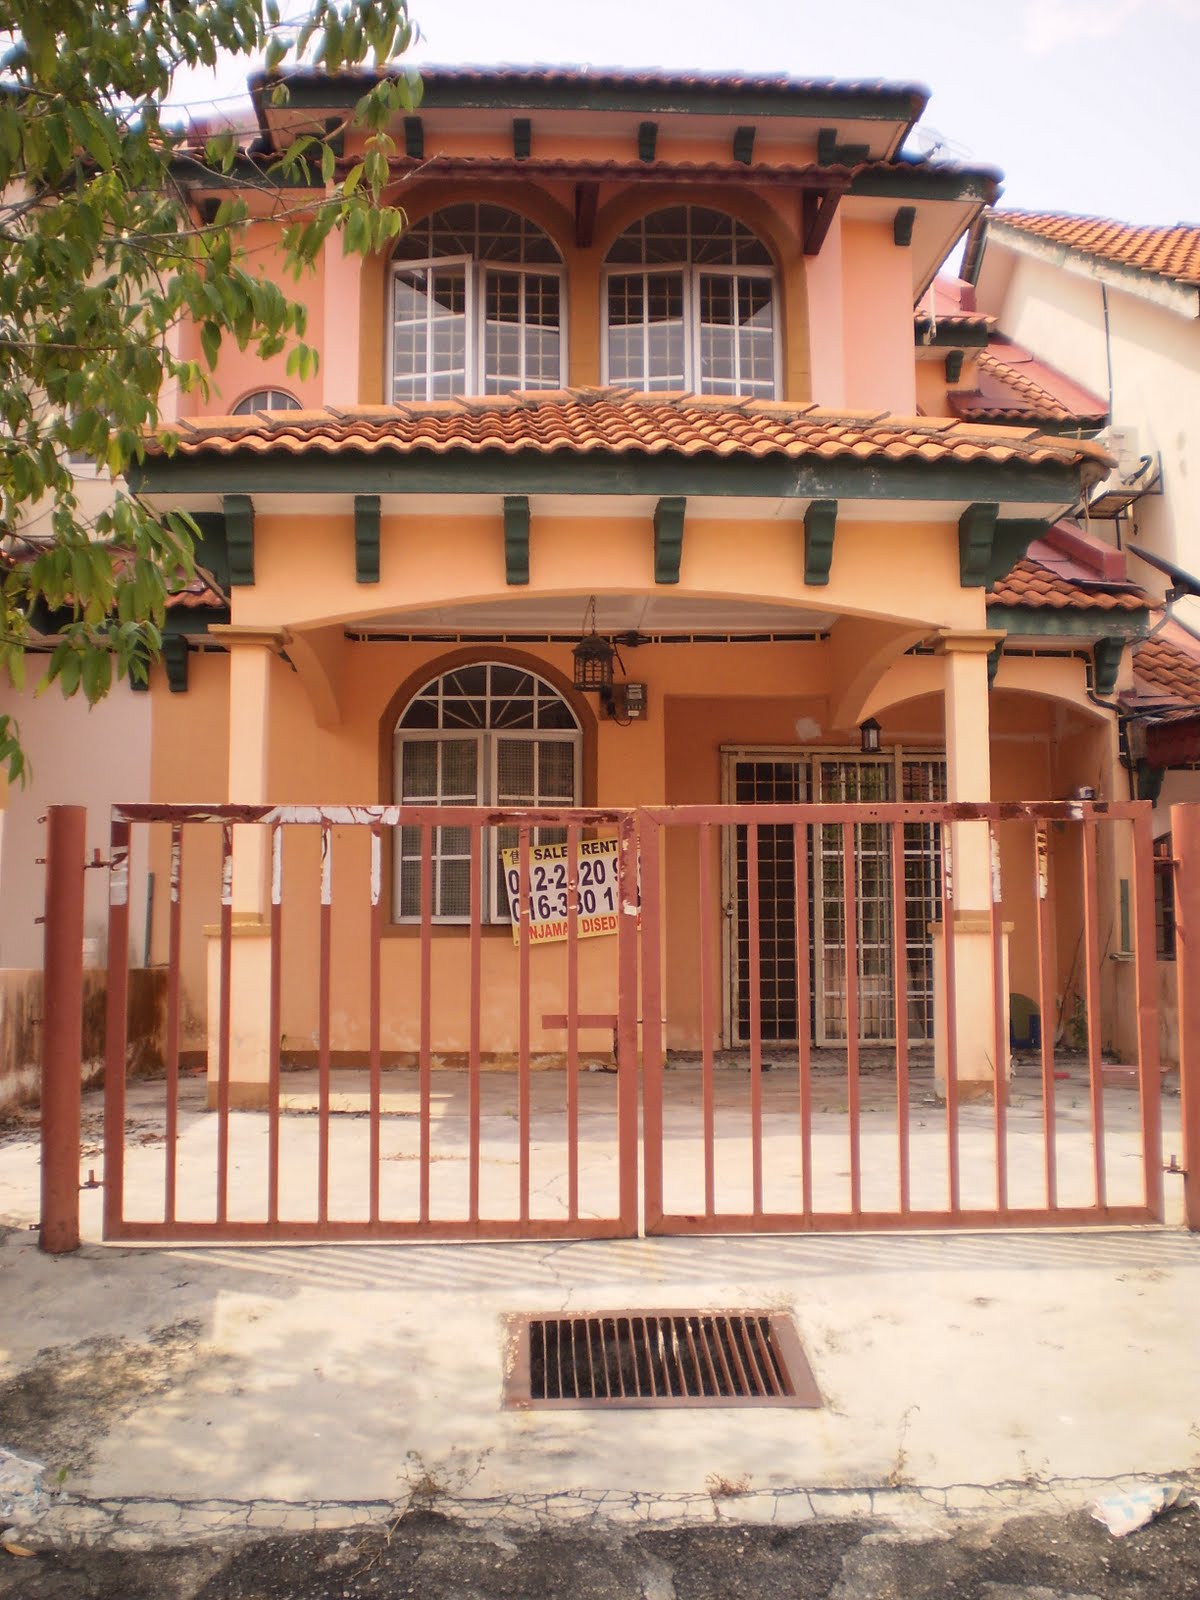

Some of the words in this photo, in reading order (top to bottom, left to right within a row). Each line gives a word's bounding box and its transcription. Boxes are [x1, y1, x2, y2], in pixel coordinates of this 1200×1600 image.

[534, 846, 568, 860] SALE
[581, 839, 618, 855] RENT
[508, 859, 606, 896] 02-220
